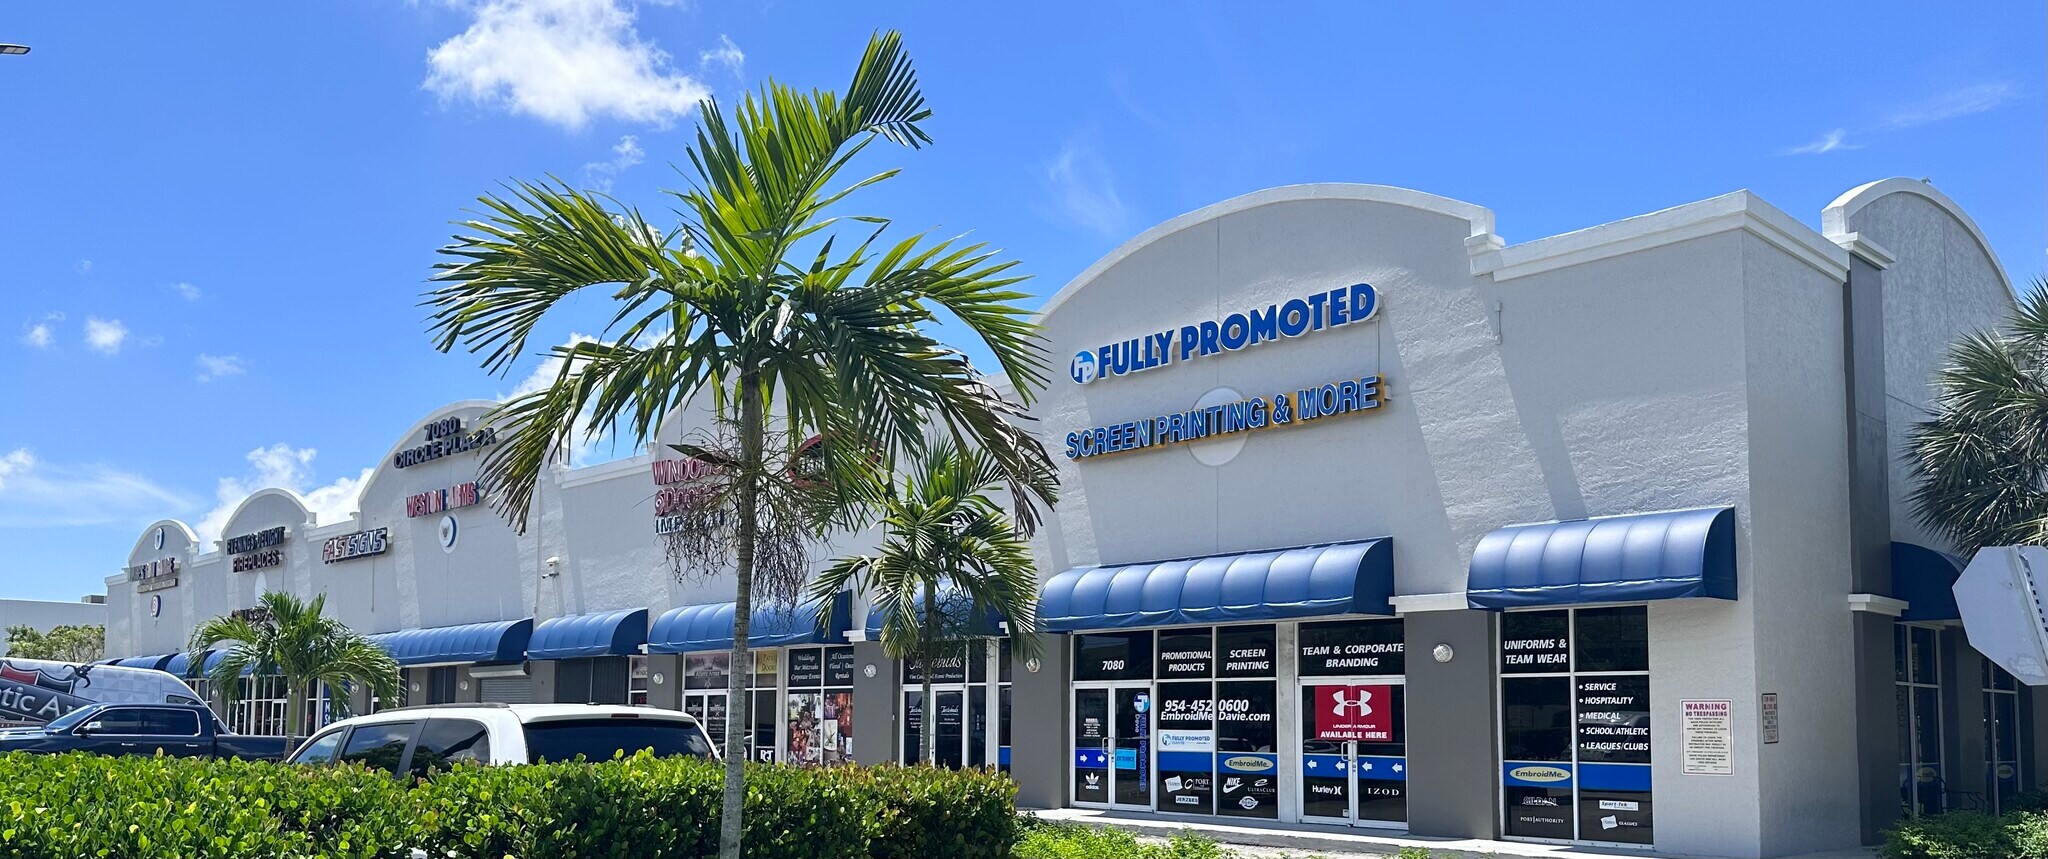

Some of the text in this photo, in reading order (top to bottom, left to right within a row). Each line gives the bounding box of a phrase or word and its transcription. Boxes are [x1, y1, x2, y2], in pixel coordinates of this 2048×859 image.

[1098, 329, 1175, 379] FULLY
[1181, 282, 1379, 361] PROMOTED
[1065, 375, 1383, 459] SCREEN PRINTING & MORE
[424, 416, 461, 441] 7080
[394, 427, 497, 468] CIRCLE PLAZA
[447, 481, 480, 509] ARMS
[233, 550, 280, 573] FIREPLACES
[1504, 638, 1567, 650] UNIFORMS &
[1229, 649, 1266, 658] SCREEN
[1302, 643, 1404, 656] TEAM & CORPORATE
[1161, 650, 1213, 660] PROMOTIONAL
[1505, 653, 1567, 665] TEAM WEAR
[1102, 660, 1125, 671] 7080
[1168, 663, 1205, 672] PRODUCTS
[1226, 661, 1269, 671] PRINTING
[1325, 657, 1379, 668] BRANDING
[1584, 683, 1617, 691] SERVICE
[1584, 697, 1634, 705] HOSPITALITY
[1585, 712, 1621, 720] MEDICAL
[1320, 731, 1387, 739] AVAILABLE HERE
[1585, 727, 1649, 736] SCHOOL/ATHLETIC
[1585, 742, 1649, 751] LEAGUES/CLUBS
[1226, 777, 1241, 786] NIKE
[1312, 785, 1334, 794] Hurley
[1367, 787, 1400, 796] IZOD
